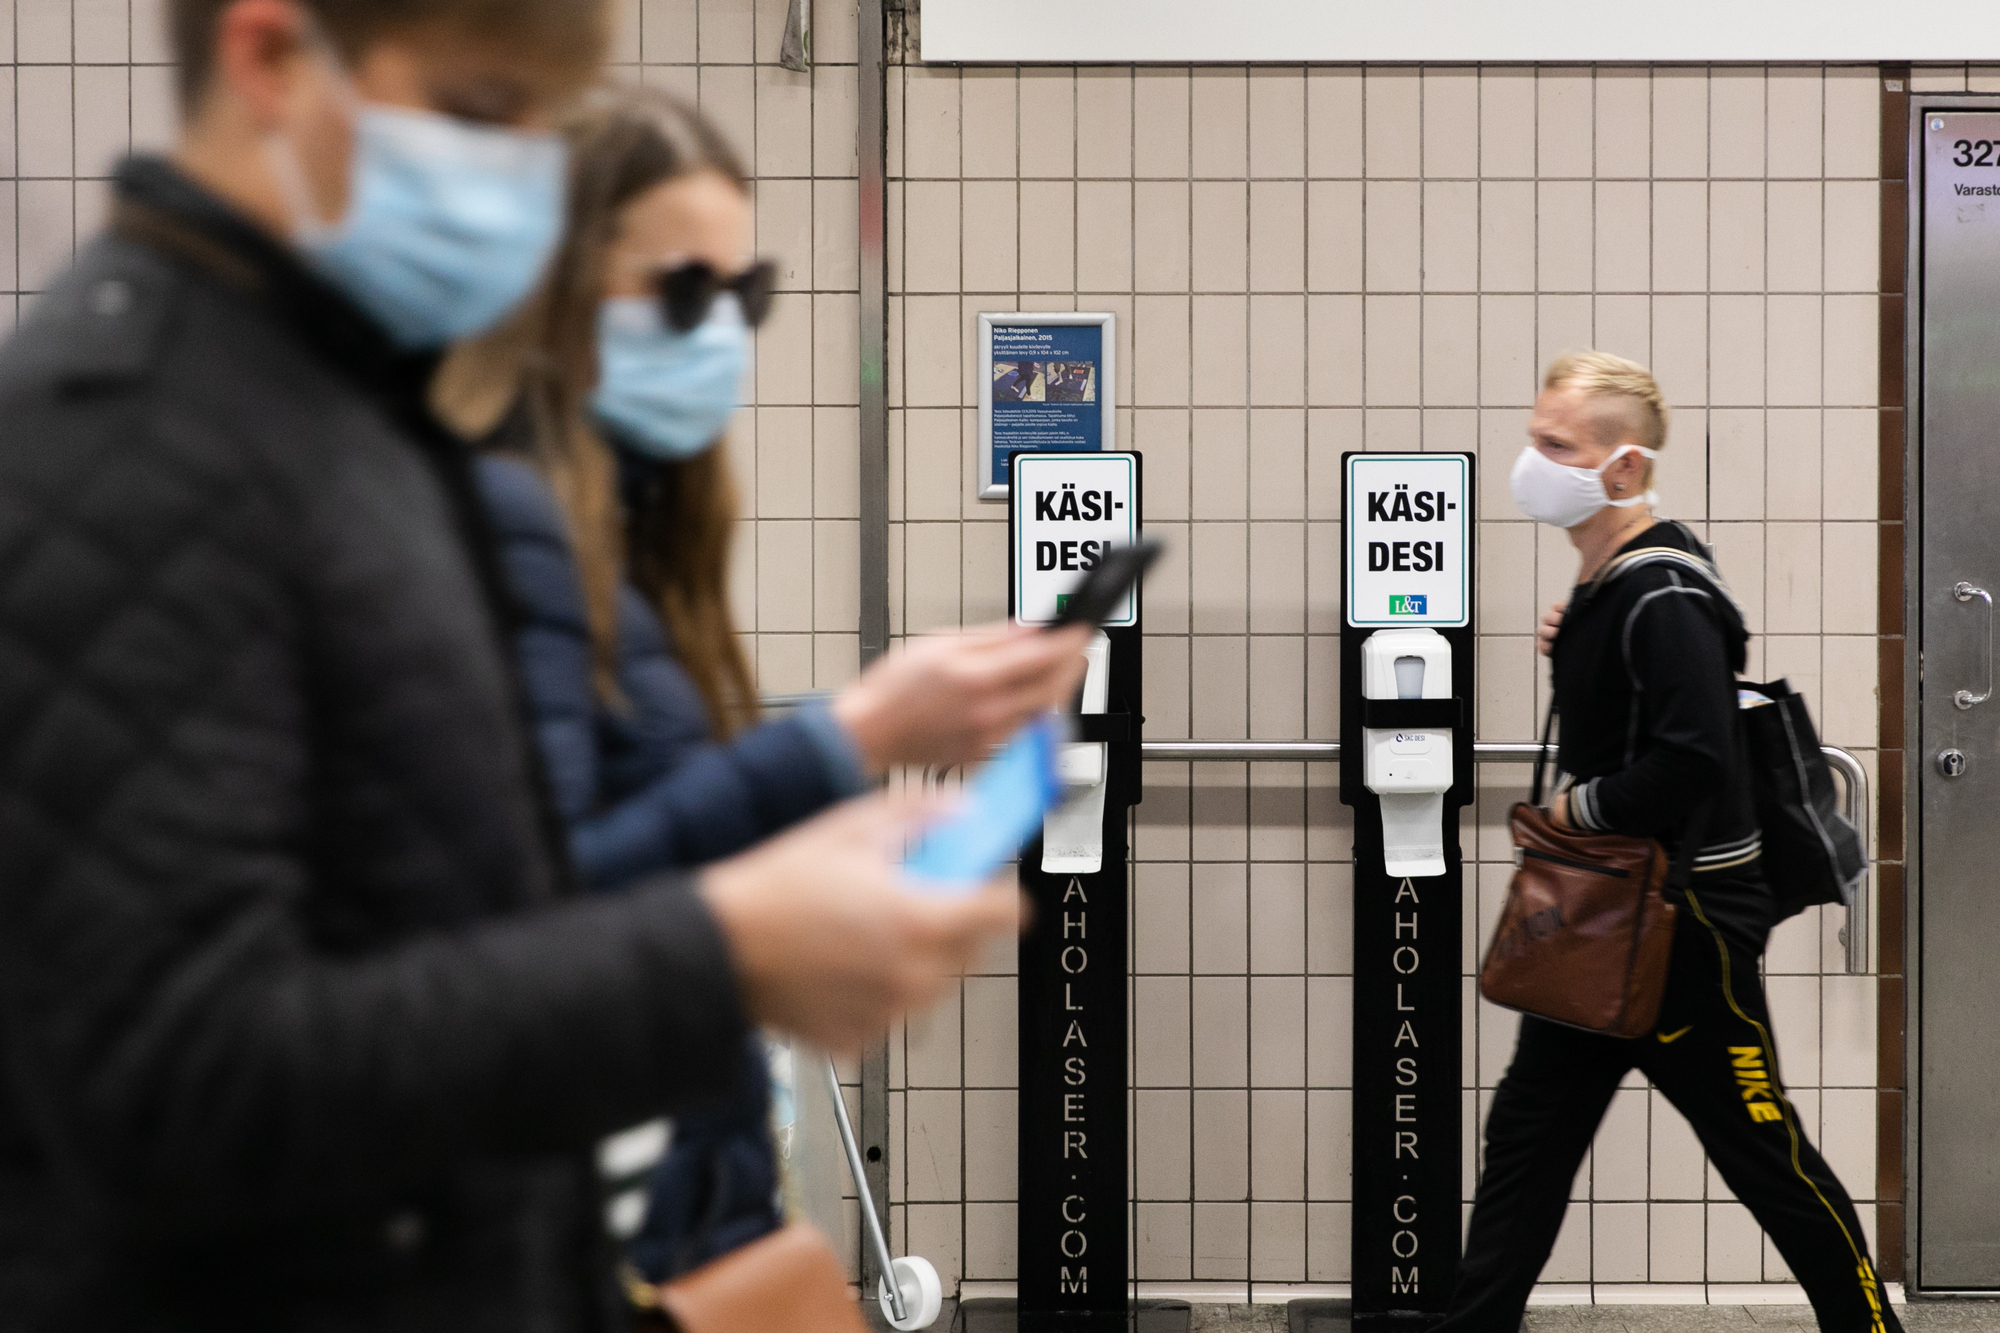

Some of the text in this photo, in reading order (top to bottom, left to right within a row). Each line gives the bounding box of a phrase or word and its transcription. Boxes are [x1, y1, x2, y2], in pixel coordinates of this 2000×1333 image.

[1954, 183, 2000, 196] Varast
[1036, 483, 1123, 521] KÄSI-
[1368, 484, 1456, 522] KÄSI-
[1368, 541, 1443, 572] DESI
[1395, 595, 1422, 613] L&T
[1727, 1046, 1783, 1123] NIKE
